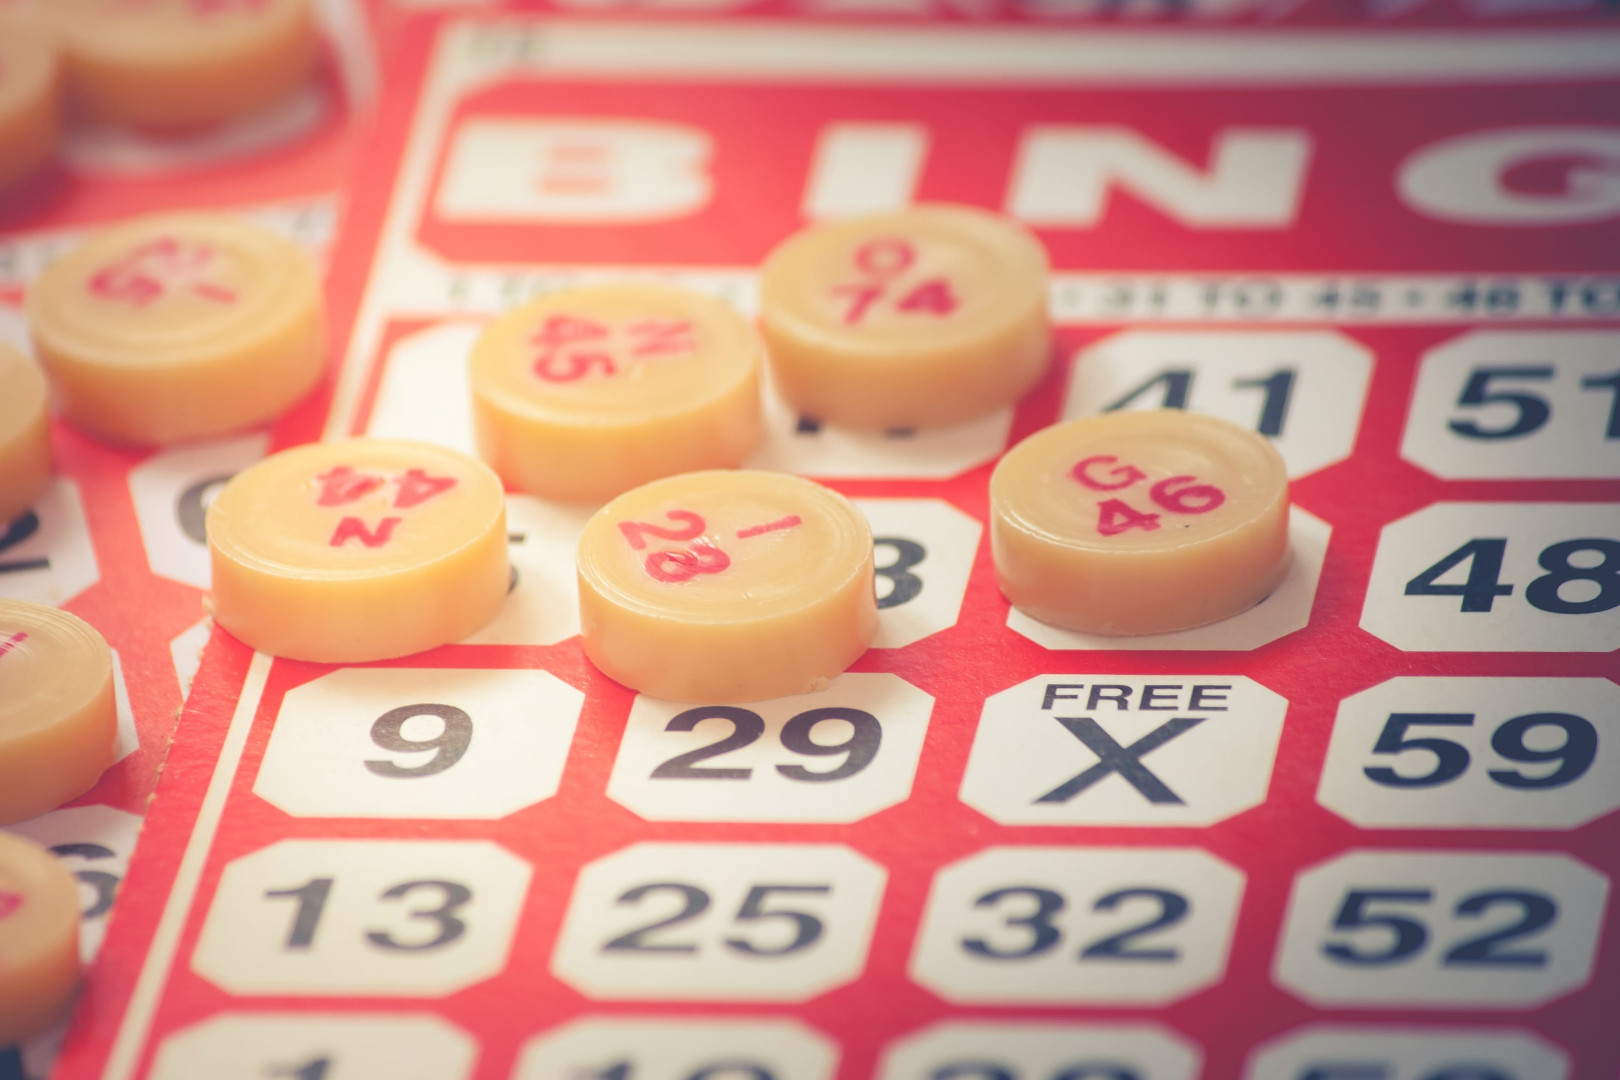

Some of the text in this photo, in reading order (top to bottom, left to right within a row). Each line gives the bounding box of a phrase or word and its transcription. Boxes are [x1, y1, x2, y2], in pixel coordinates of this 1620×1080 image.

[853, 237, 916, 280] O
[830, 280, 961, 323] 74
[317, 466, 458, 509] 44
[1066, 454, 1147, 492] G
[329, 516, 402, 549] N
[1403, 536, 1620, 616] 48
[1041, 683, 1232, 712] FREE
[364, 703, 474, 780] 9
[649, 705, 883, 782] 29
[1033, 717, 1210, 806] X
[1362, 711, 1600, 792] 59
[264, 876, 474, 954] 13
[600, 881, 834, 958] 25
[960, 885, 1192, 964] 32
[1320, 886, 1562, 972] 52
